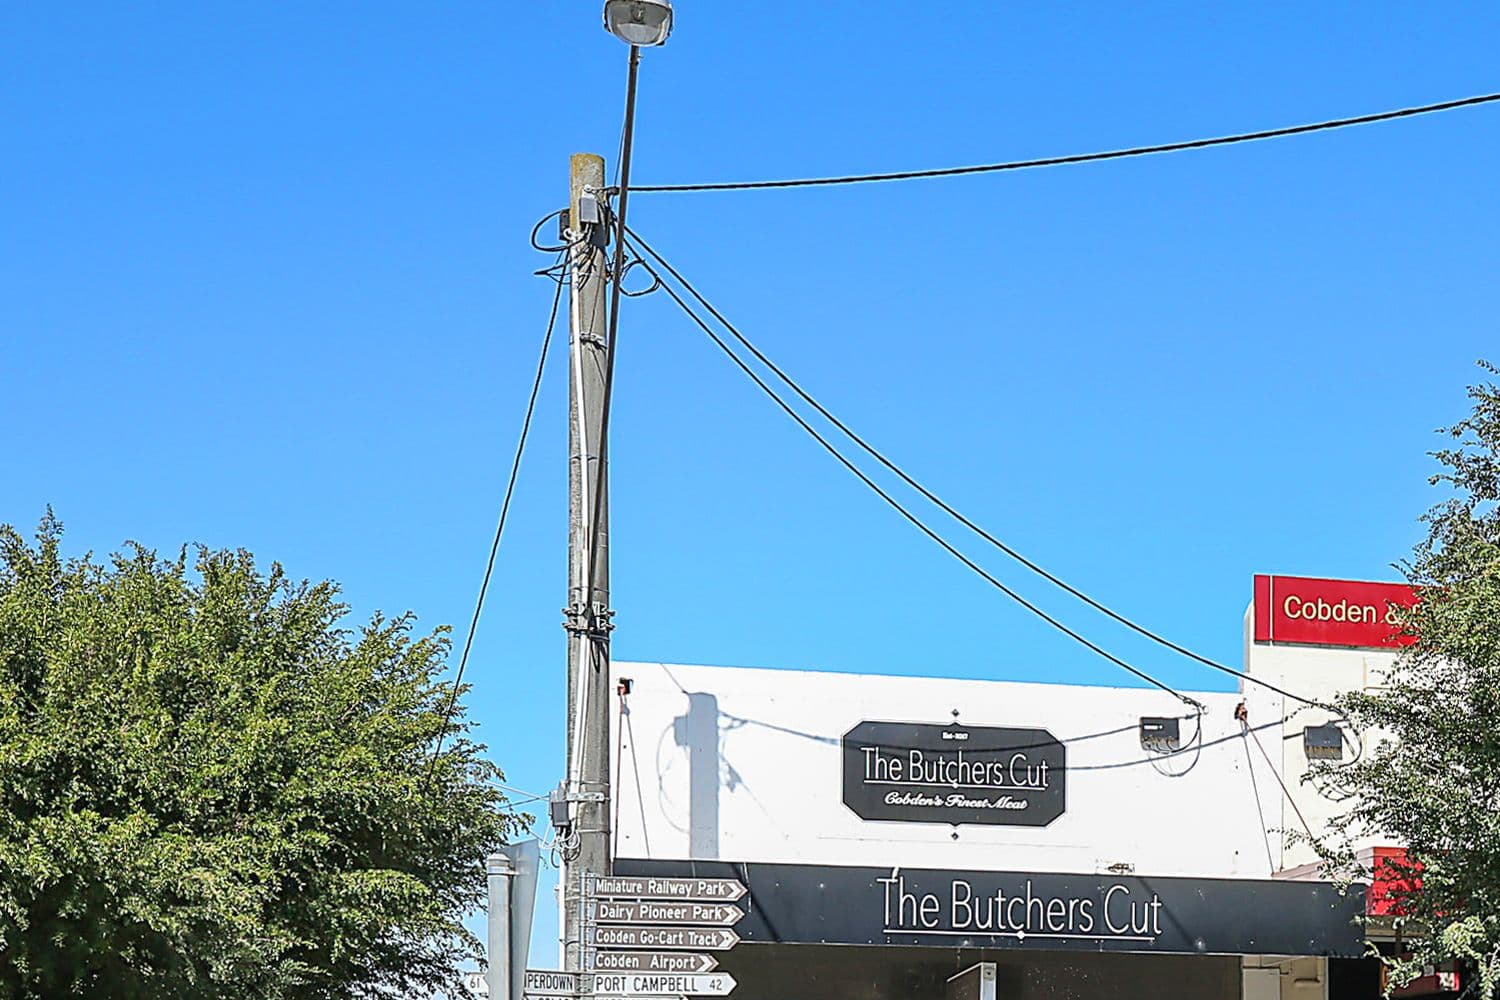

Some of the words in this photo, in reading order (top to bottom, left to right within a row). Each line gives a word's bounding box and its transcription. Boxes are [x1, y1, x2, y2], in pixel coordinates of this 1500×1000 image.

[1284, 595, 1377, 624] Cobden
[860, 746, 903, 781] The
[909, 749, 1004, 785] Butchers
[1009, 753, 1049, 787] Cut
[885, 791, 944, 806] Cobden's
[944, 793, 990, 808] Finest
[596, 879, 643, 894] Miniature
[648, 880, 693, 898] Railway
[698, 881, 725, 896] Park
[601, 905, 634, 921] Dairy
[639, 905, 687, 920] Pioneer
[693, 906, 722, 920] Park
[876, 876, 940, 927] The
[952, 880, 1094, 932] Butchers
[1104, 884, 1162, 935] Cut
[596, 929, 636, 944] Cobden
[640, 930, 684, 945] Go-Cart
[688, 931, 717, 946] Track
[596, 954, 639, 968] Cobden
[650, 954, 696, 971] Airport
[524, 973, 573, 990] PERDOWN
[596, 976, 627, 992] PORT
[633, 977, 699, 992] CAMPBELL
[709, 979, 723, 991] 42
